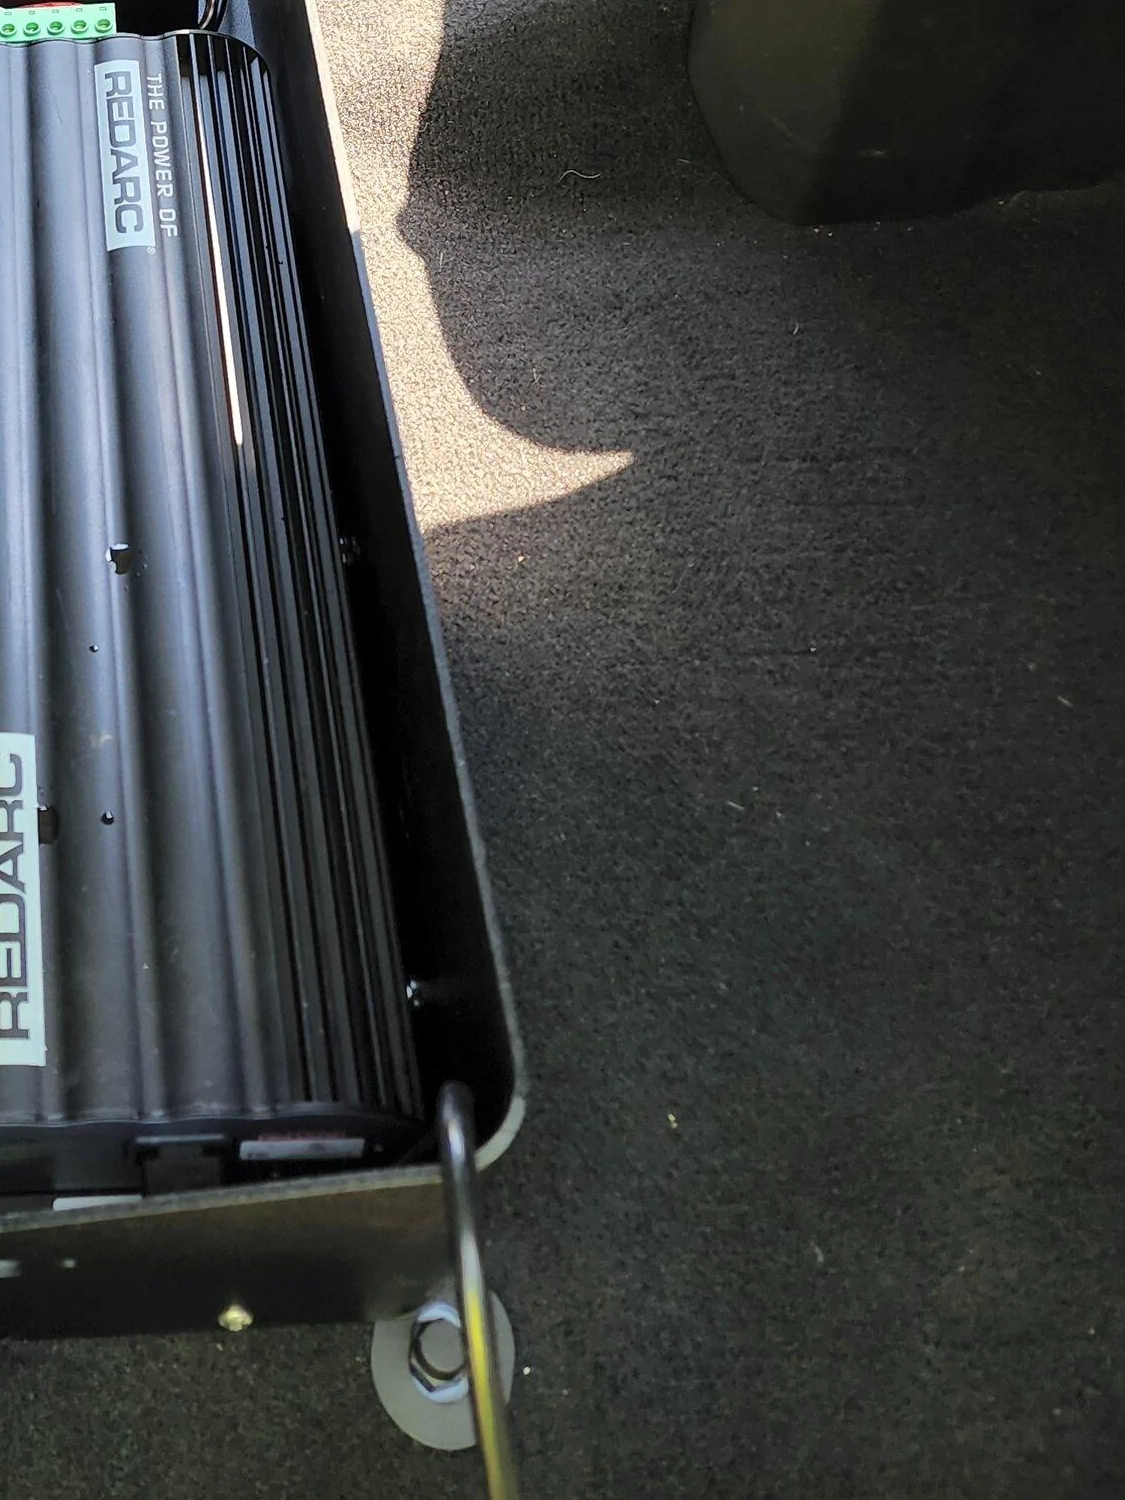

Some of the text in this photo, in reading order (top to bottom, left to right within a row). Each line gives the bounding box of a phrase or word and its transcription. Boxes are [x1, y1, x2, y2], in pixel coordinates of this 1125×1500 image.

[104, 70, 144, 234] REDARC
[146, 74, 179, 238] THE POWER OF
